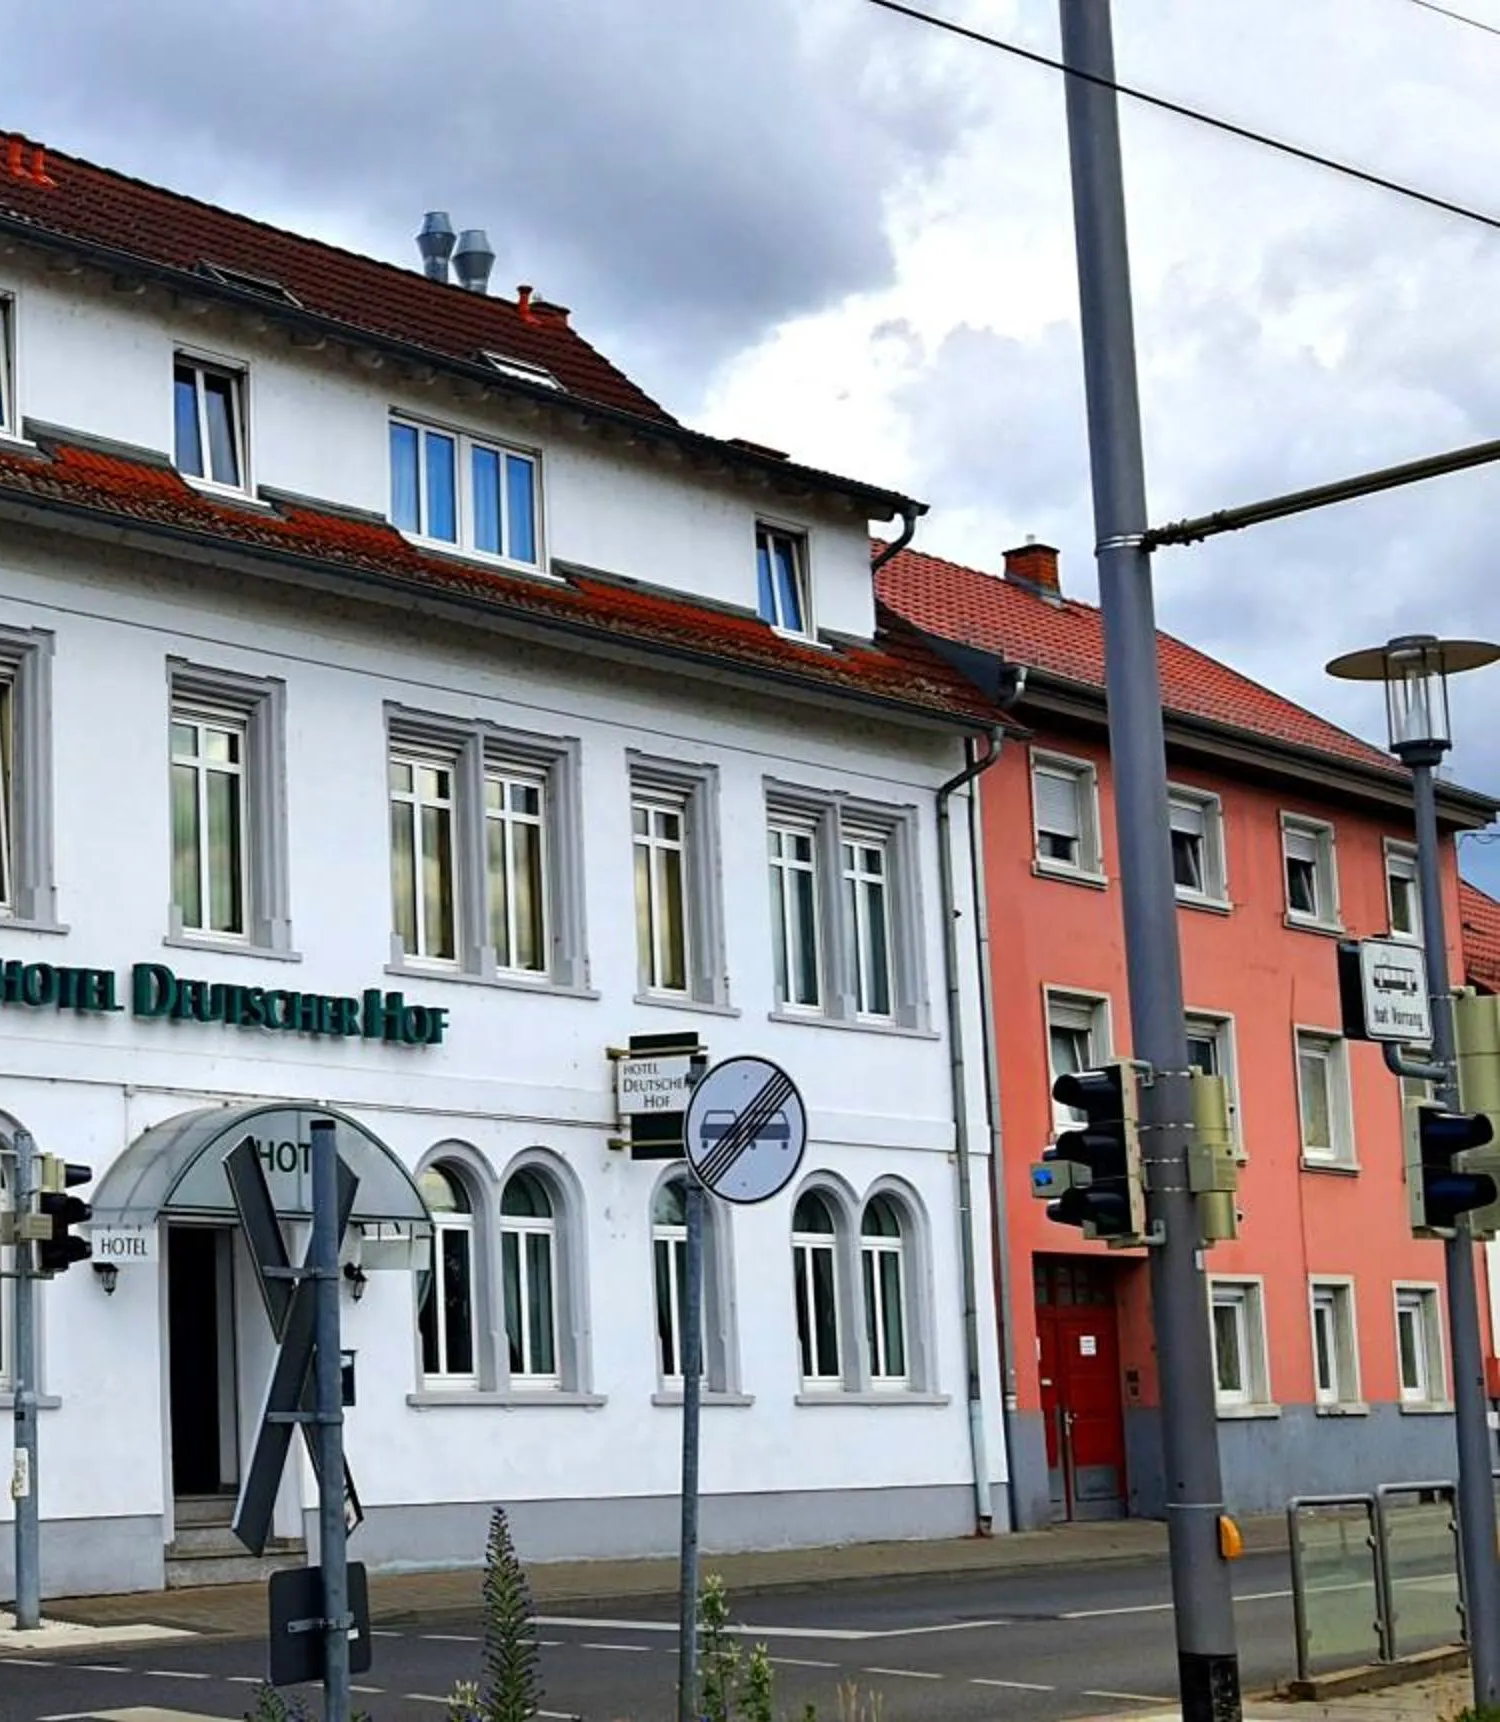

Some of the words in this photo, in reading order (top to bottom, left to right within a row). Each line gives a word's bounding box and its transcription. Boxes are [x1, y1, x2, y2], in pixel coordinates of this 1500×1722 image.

[132, 963, 361, 1037] DEUTSCHER
[363, 988, 449, 1044] HOF
[623, 1063, 659, 1075] HOTEL
[623, 1076, 689, 1093] DEUTSCHE
[643, 1094, 671, 1109] HOF
[257, 1140, 312, 1174] HOT
[101, 1237, 148, 1256] HOTEL
